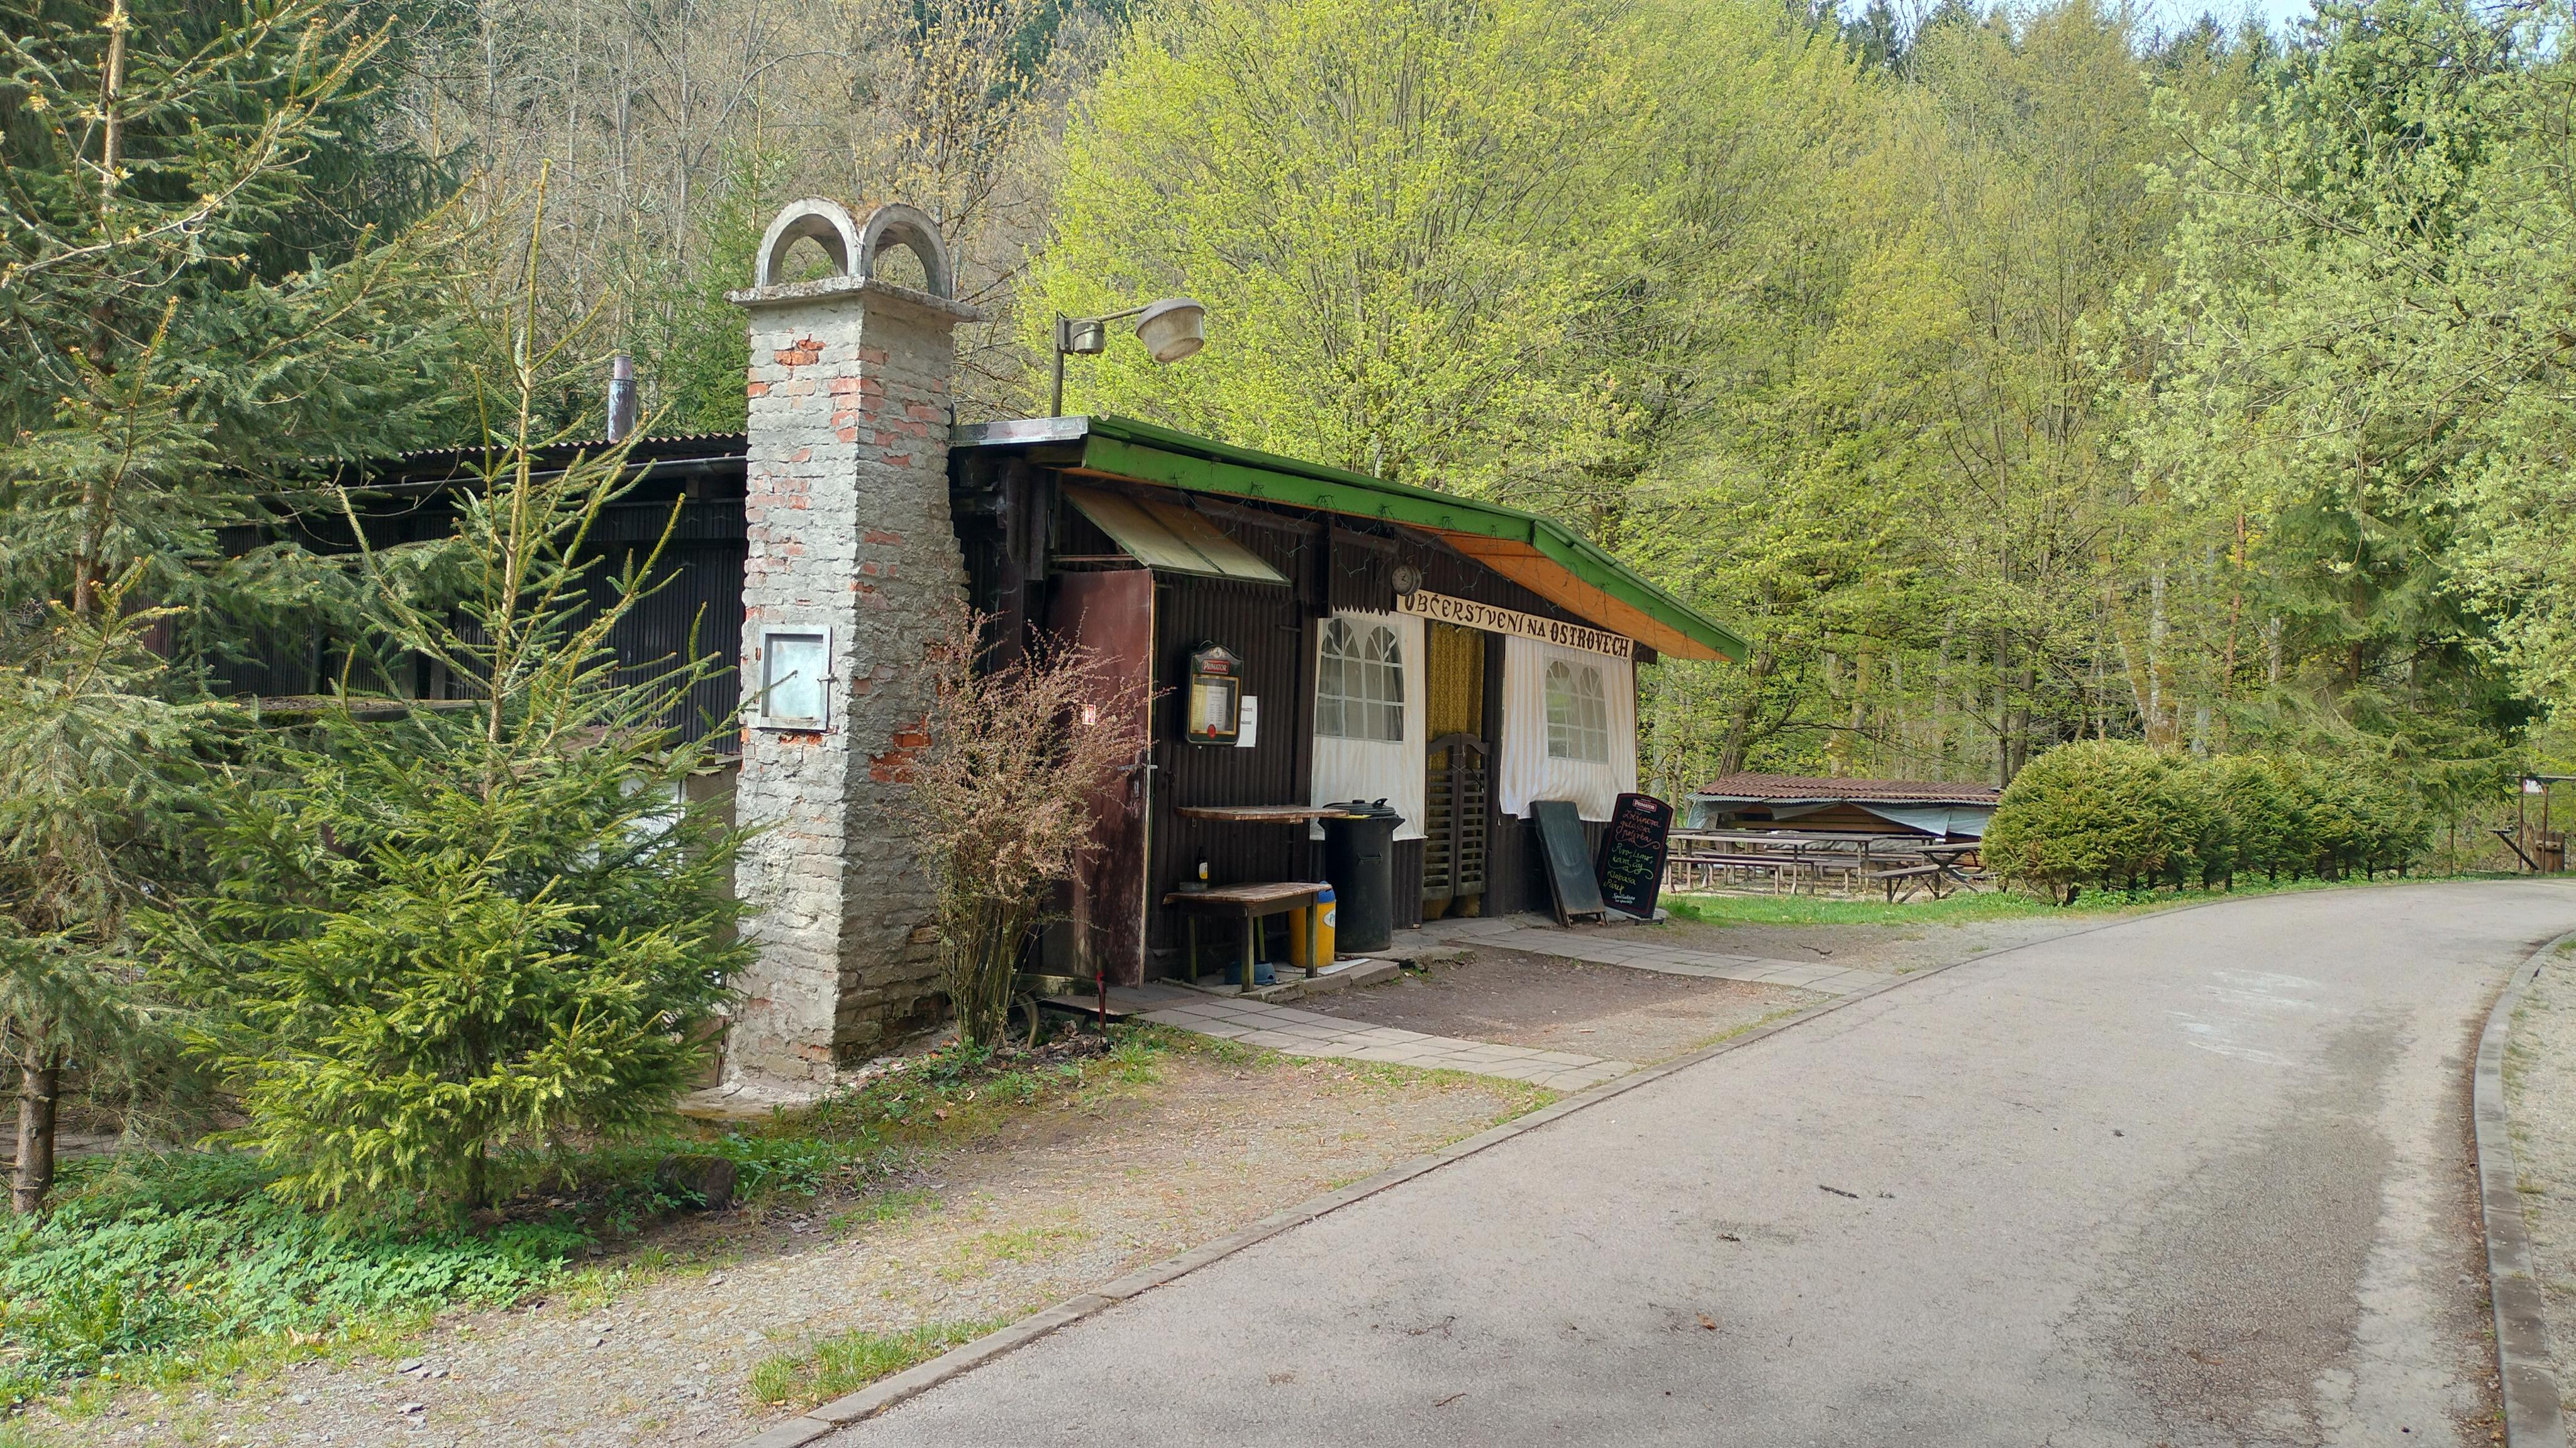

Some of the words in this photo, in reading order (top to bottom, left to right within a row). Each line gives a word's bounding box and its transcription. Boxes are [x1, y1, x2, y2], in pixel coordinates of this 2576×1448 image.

[1404, 594, 1526, 633] OBČERSTVENÍ
[1527, 618, 1546, 638] NA
[1550, 621, 1630, 658] OSTROVECH
[1204, 661, 1228, 672] PRIMATOR
